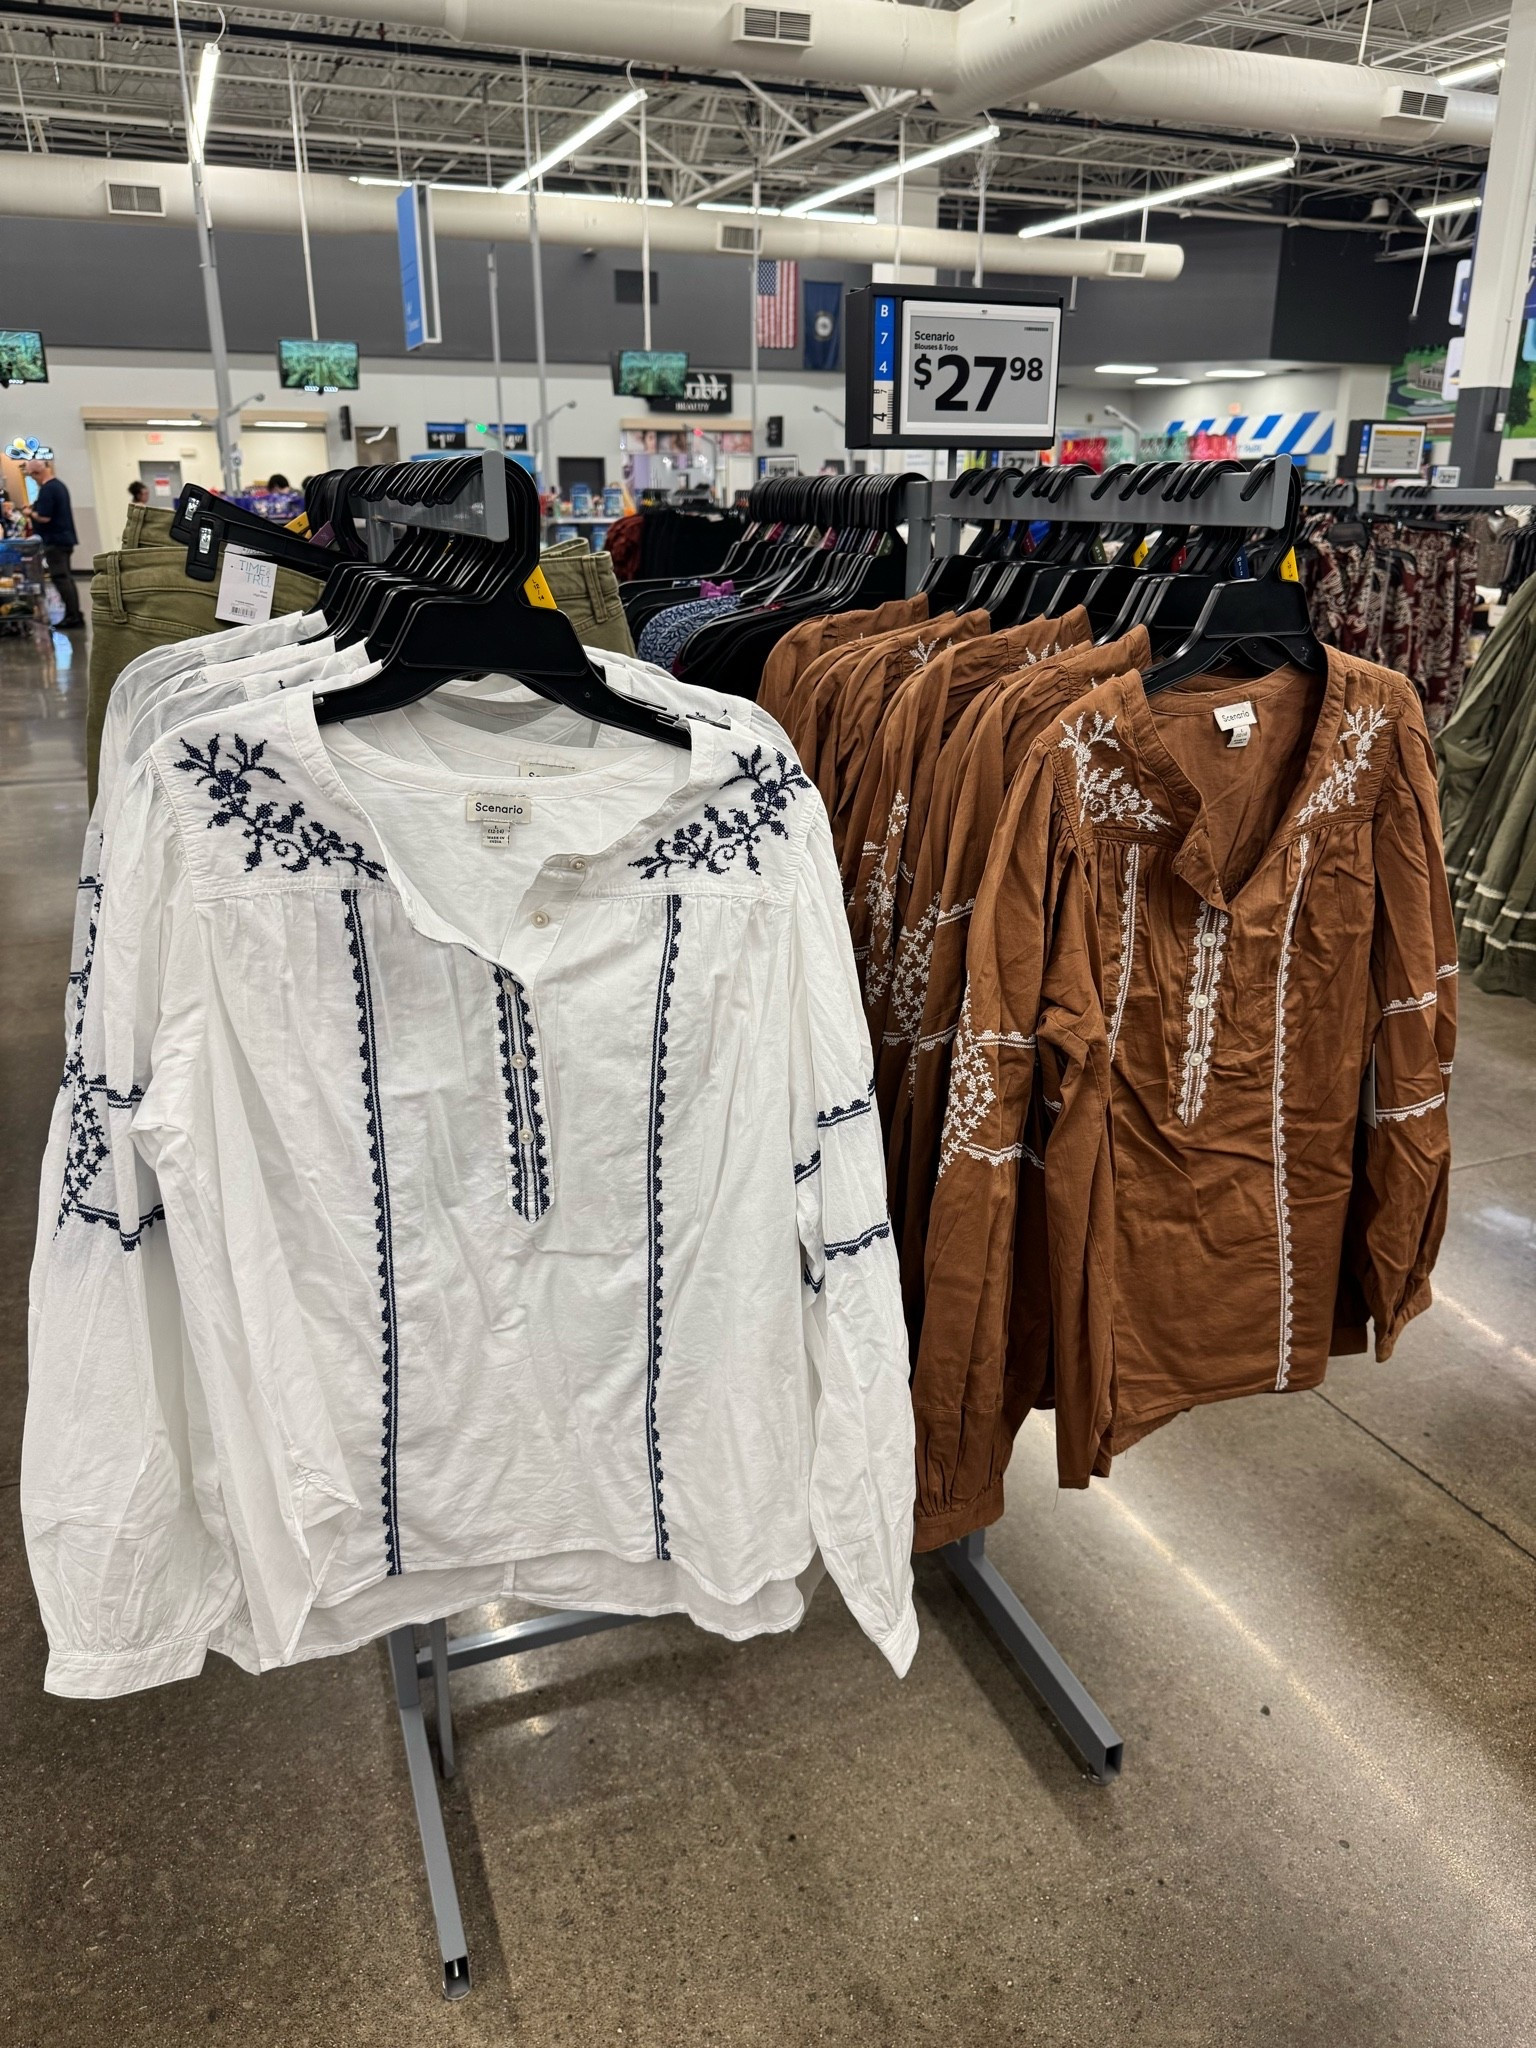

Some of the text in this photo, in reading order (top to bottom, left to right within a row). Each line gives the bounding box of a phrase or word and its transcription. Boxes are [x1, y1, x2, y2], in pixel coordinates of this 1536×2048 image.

[881, 304, 889, 317] B
[881, 332, 889, 345] 7
[914, 330, 955, 342] Scenario
[914, 343, 938, 351] Blouses
[944, 344, 958, 352] Tops
[879, 361, 888, 374] 4
[239, 560, 266, 577] TIME
[246, 572, 270, 588] TRU
[1222, 710, 1250, 722] Scenario
[475, 802, 523, 815] Scenario
